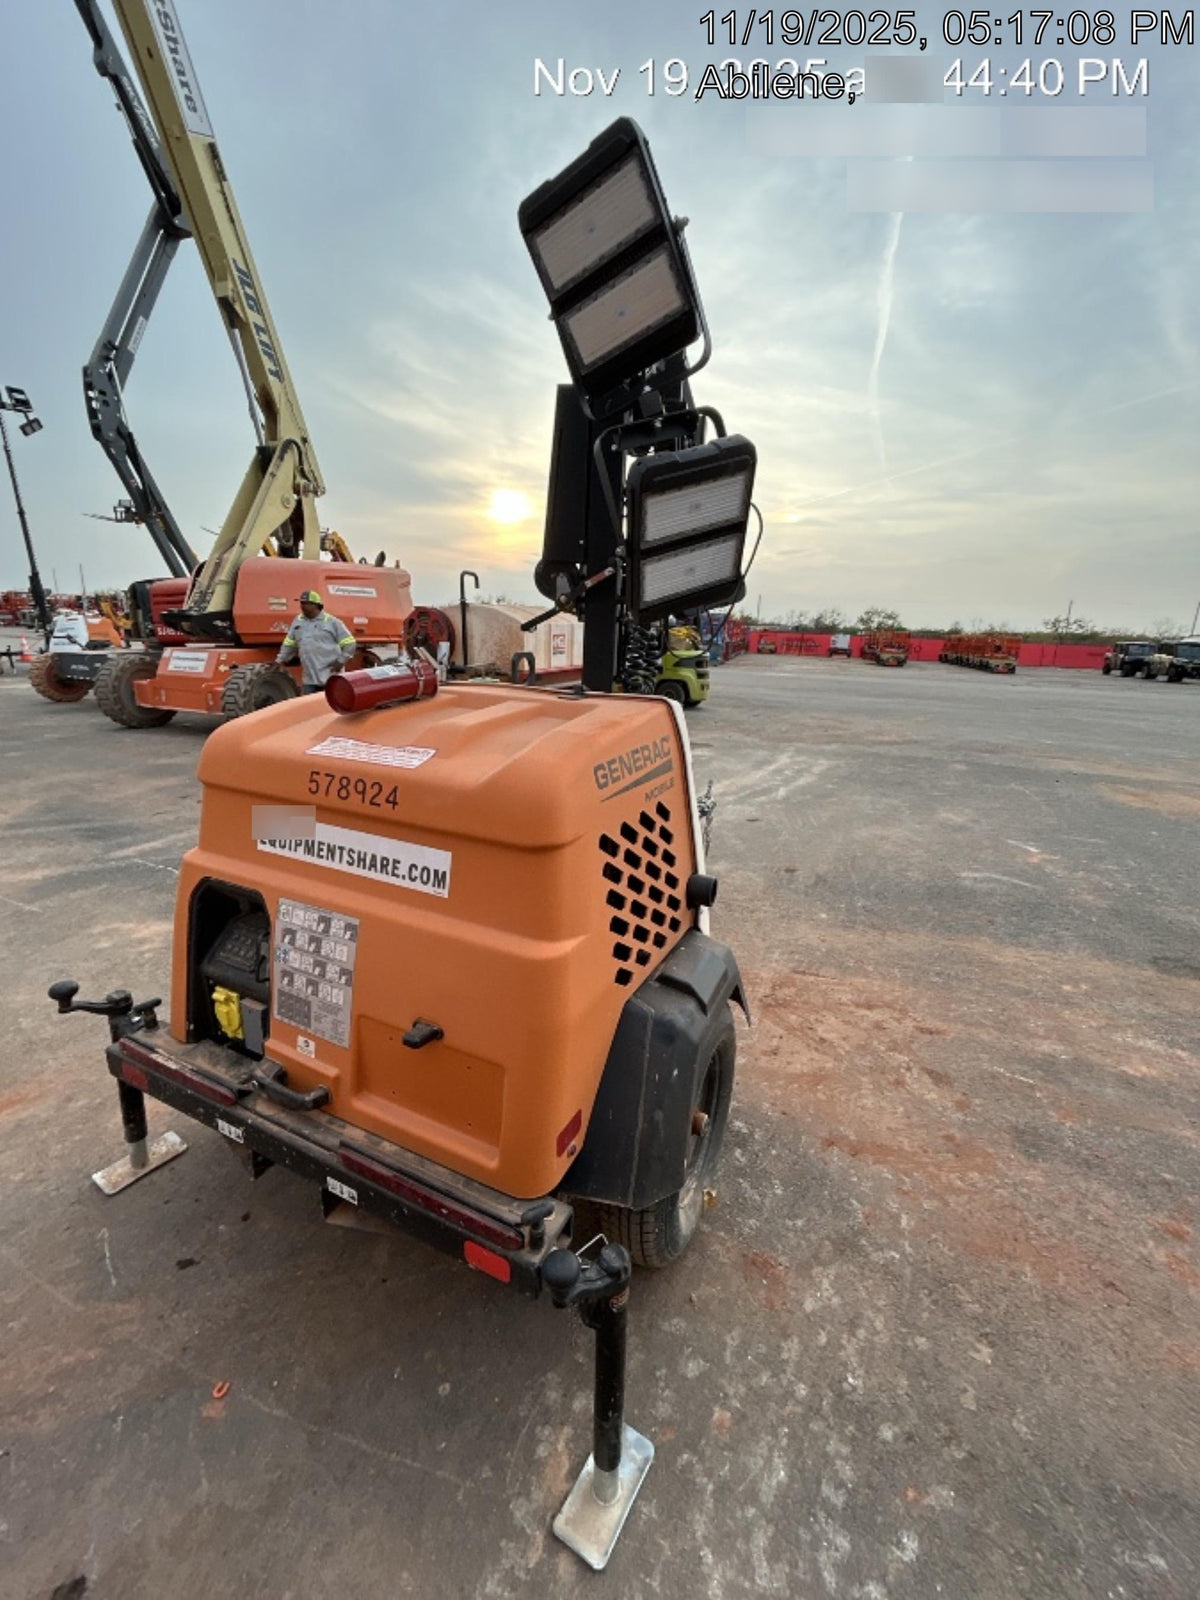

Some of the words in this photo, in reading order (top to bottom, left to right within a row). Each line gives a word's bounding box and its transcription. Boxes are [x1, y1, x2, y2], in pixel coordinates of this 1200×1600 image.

[232, 258, 263, 317] JLG
[253, 322, 285, 385] LIFT
[593, 735, 671, 790] GENERAC
[308, 771, 399, 810] 578924
